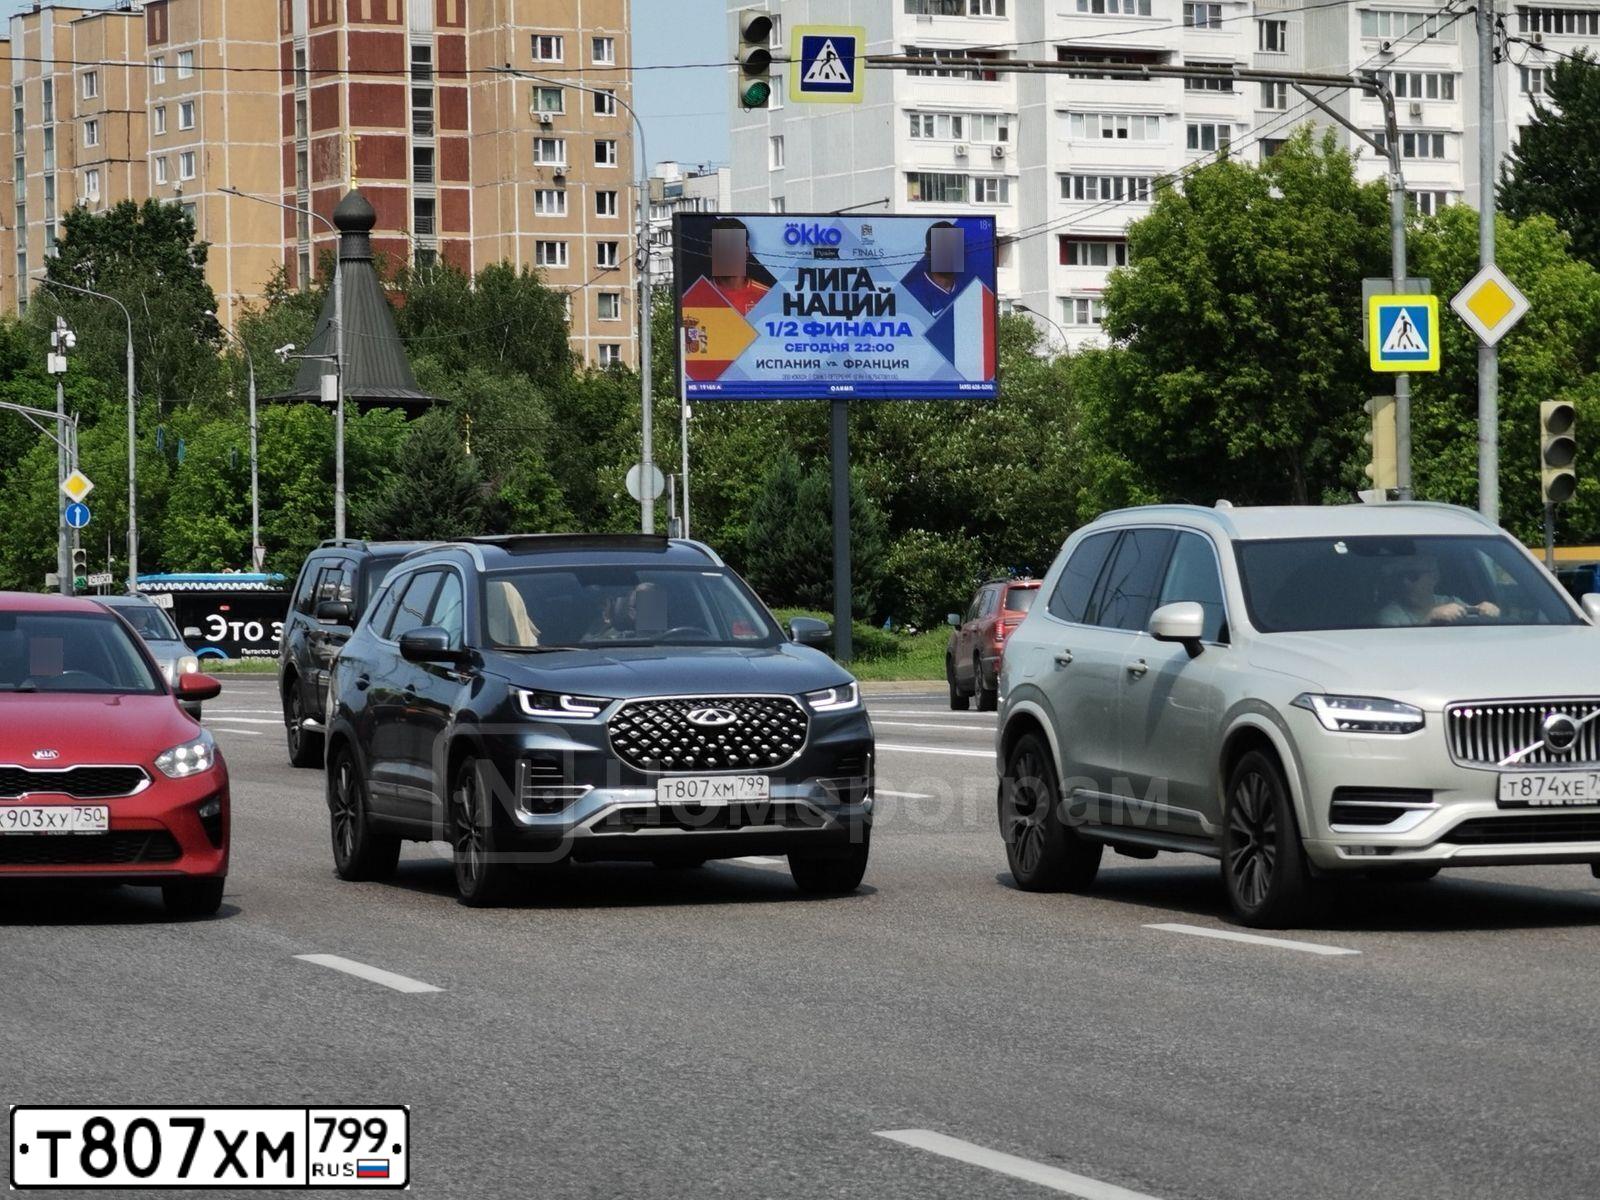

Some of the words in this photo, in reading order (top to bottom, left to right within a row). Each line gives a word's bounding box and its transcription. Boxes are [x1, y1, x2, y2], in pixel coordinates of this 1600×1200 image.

[853, 248, 884, 257] FINALS
[795, 267, 876, 292] ЛИГА
[783, 287, 896, 320] НАЦИЙ
[765, 322, 799, 337] 1/2
[803, 321, 913, 338] ФИНАЛА
[785, 343, 849, 353] СЕГОДНЯ
[854, 343, 895, 353] 22:00
[756, 359, 821, 369] ИСПАНИЯ
[843, 358, 909, 370] ФРАНЦИЯ
[205, 614, 264, 642] Это
[664, 780, 735, 799] Т807ХМ
[738, 777, 764, 791] 799
[1508, 776, 1584, 797] Т874ХЕ
[1589, 774, 1600, 790] 7
[74, 808, 102, 822] 750
